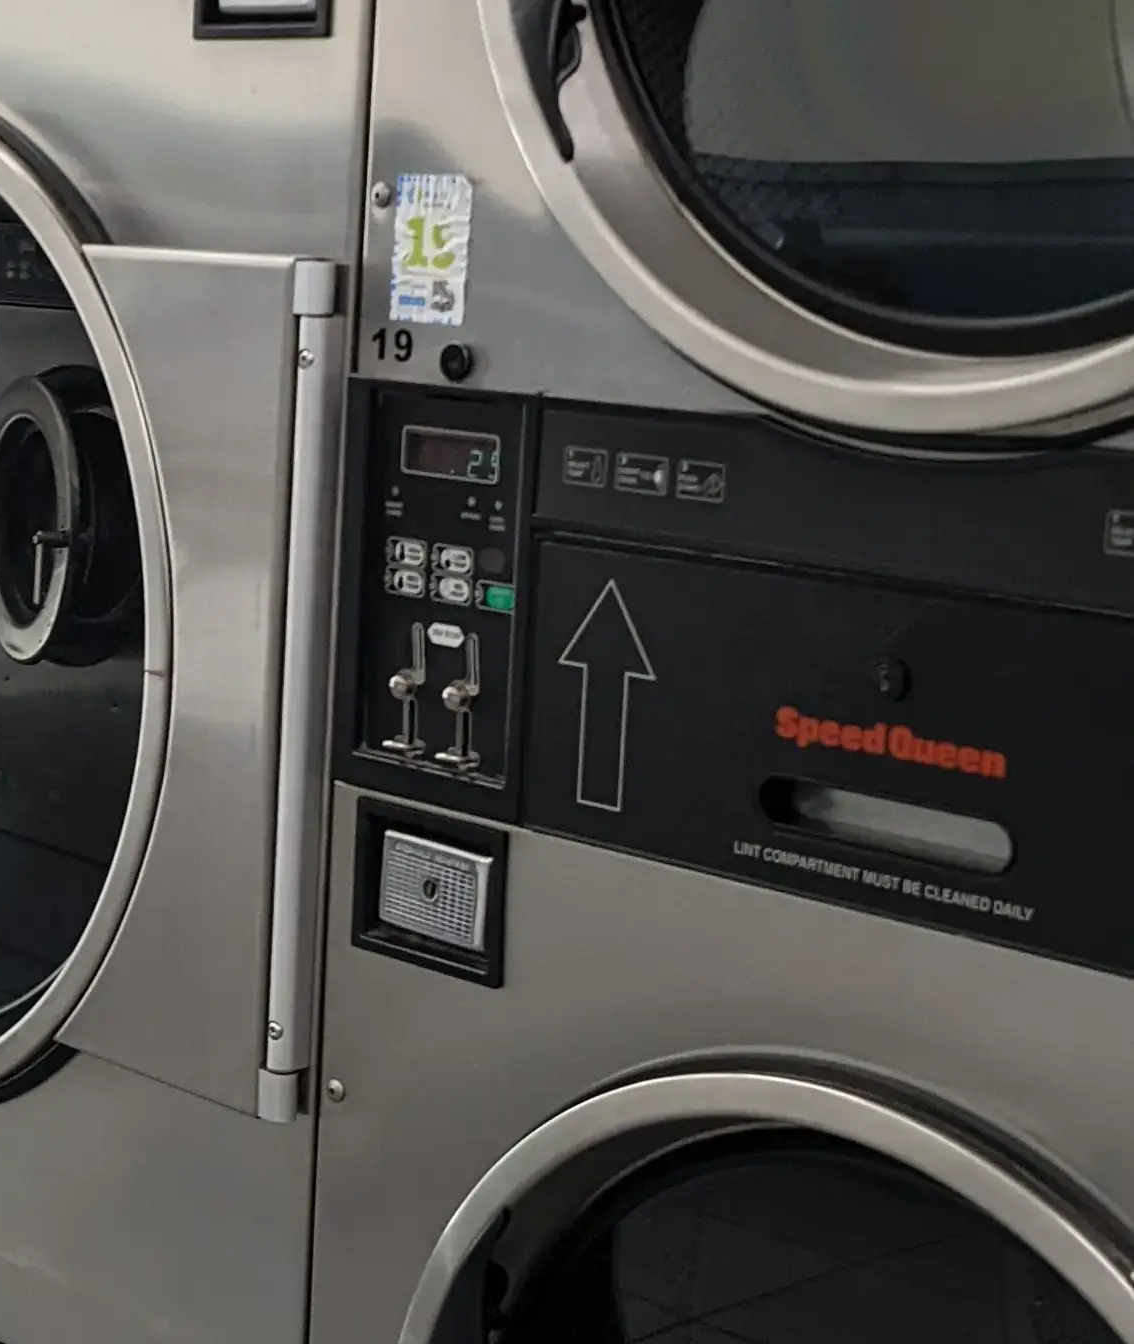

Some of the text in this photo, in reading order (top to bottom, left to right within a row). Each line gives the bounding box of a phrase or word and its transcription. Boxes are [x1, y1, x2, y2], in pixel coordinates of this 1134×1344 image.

[372, 327, 414, 363] 19
[775, 705, 1007, 779] Speed Queen
[733, 839, 1035, 921] LINT COMPARTMENT MUST BE CLEANED DAILY
